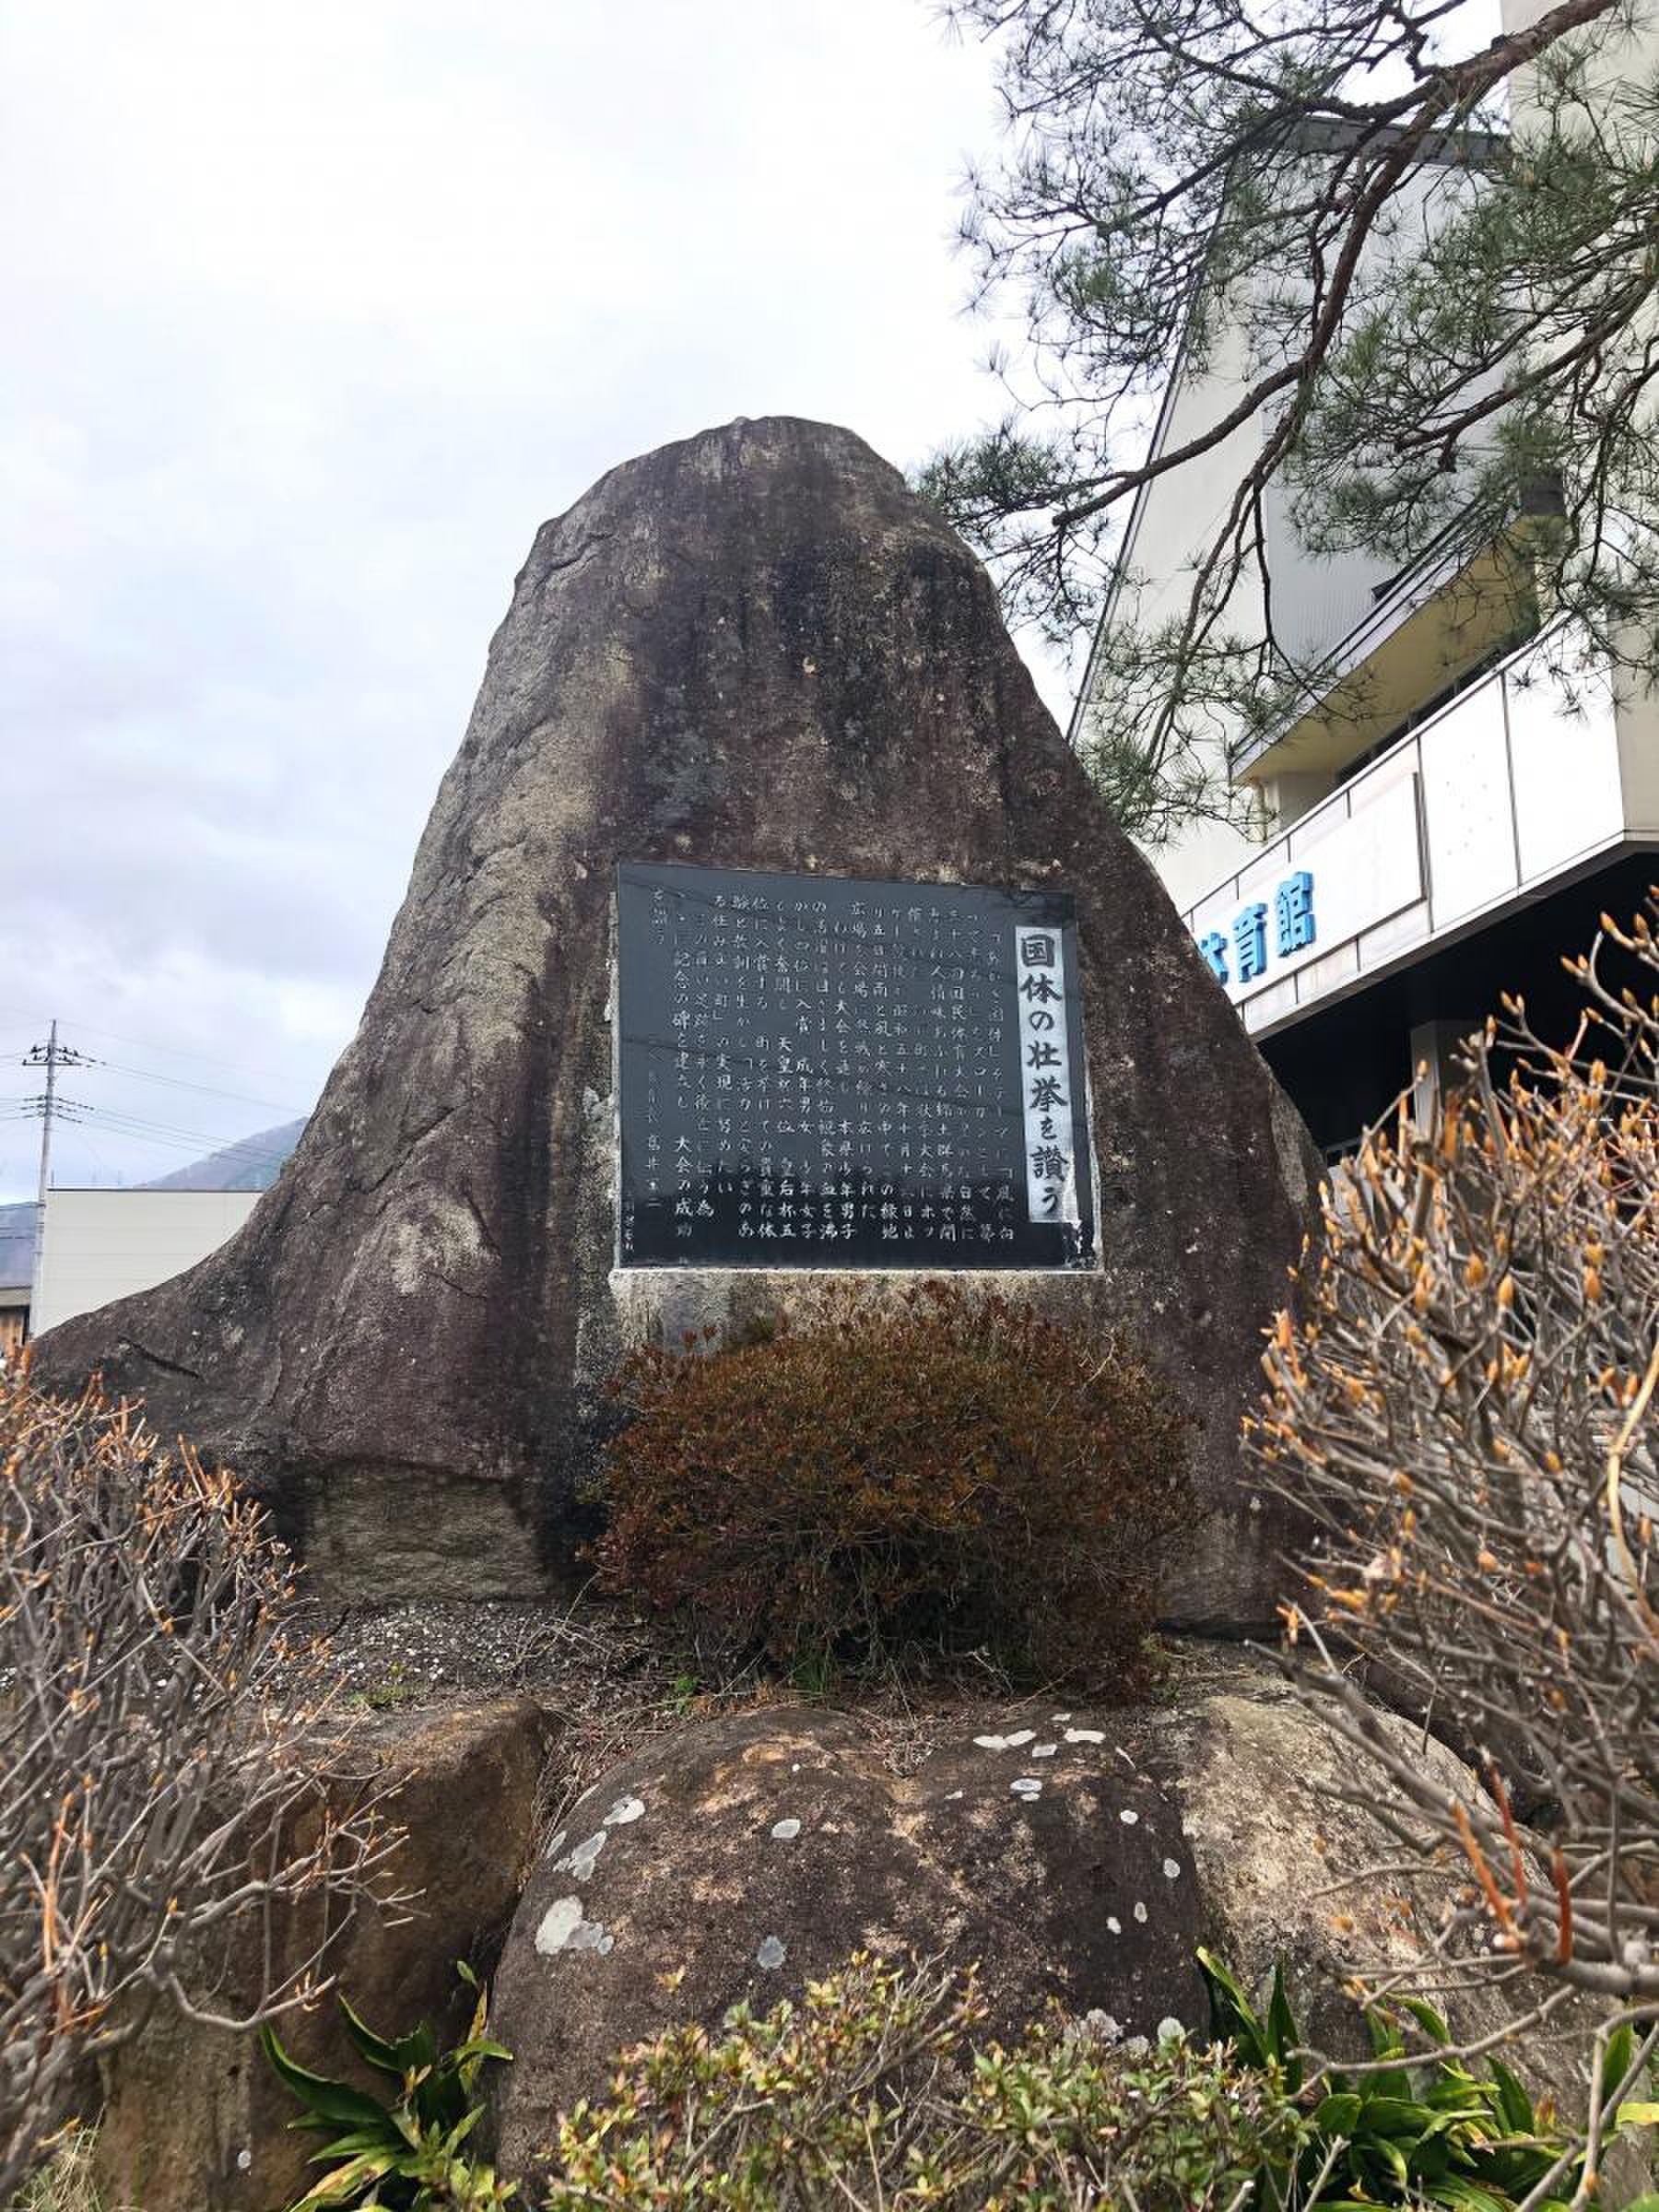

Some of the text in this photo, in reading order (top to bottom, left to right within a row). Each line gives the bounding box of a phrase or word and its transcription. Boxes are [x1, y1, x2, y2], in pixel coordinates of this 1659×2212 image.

[1019, 935, 1068, 1213] 国体の壮挙を讃う
